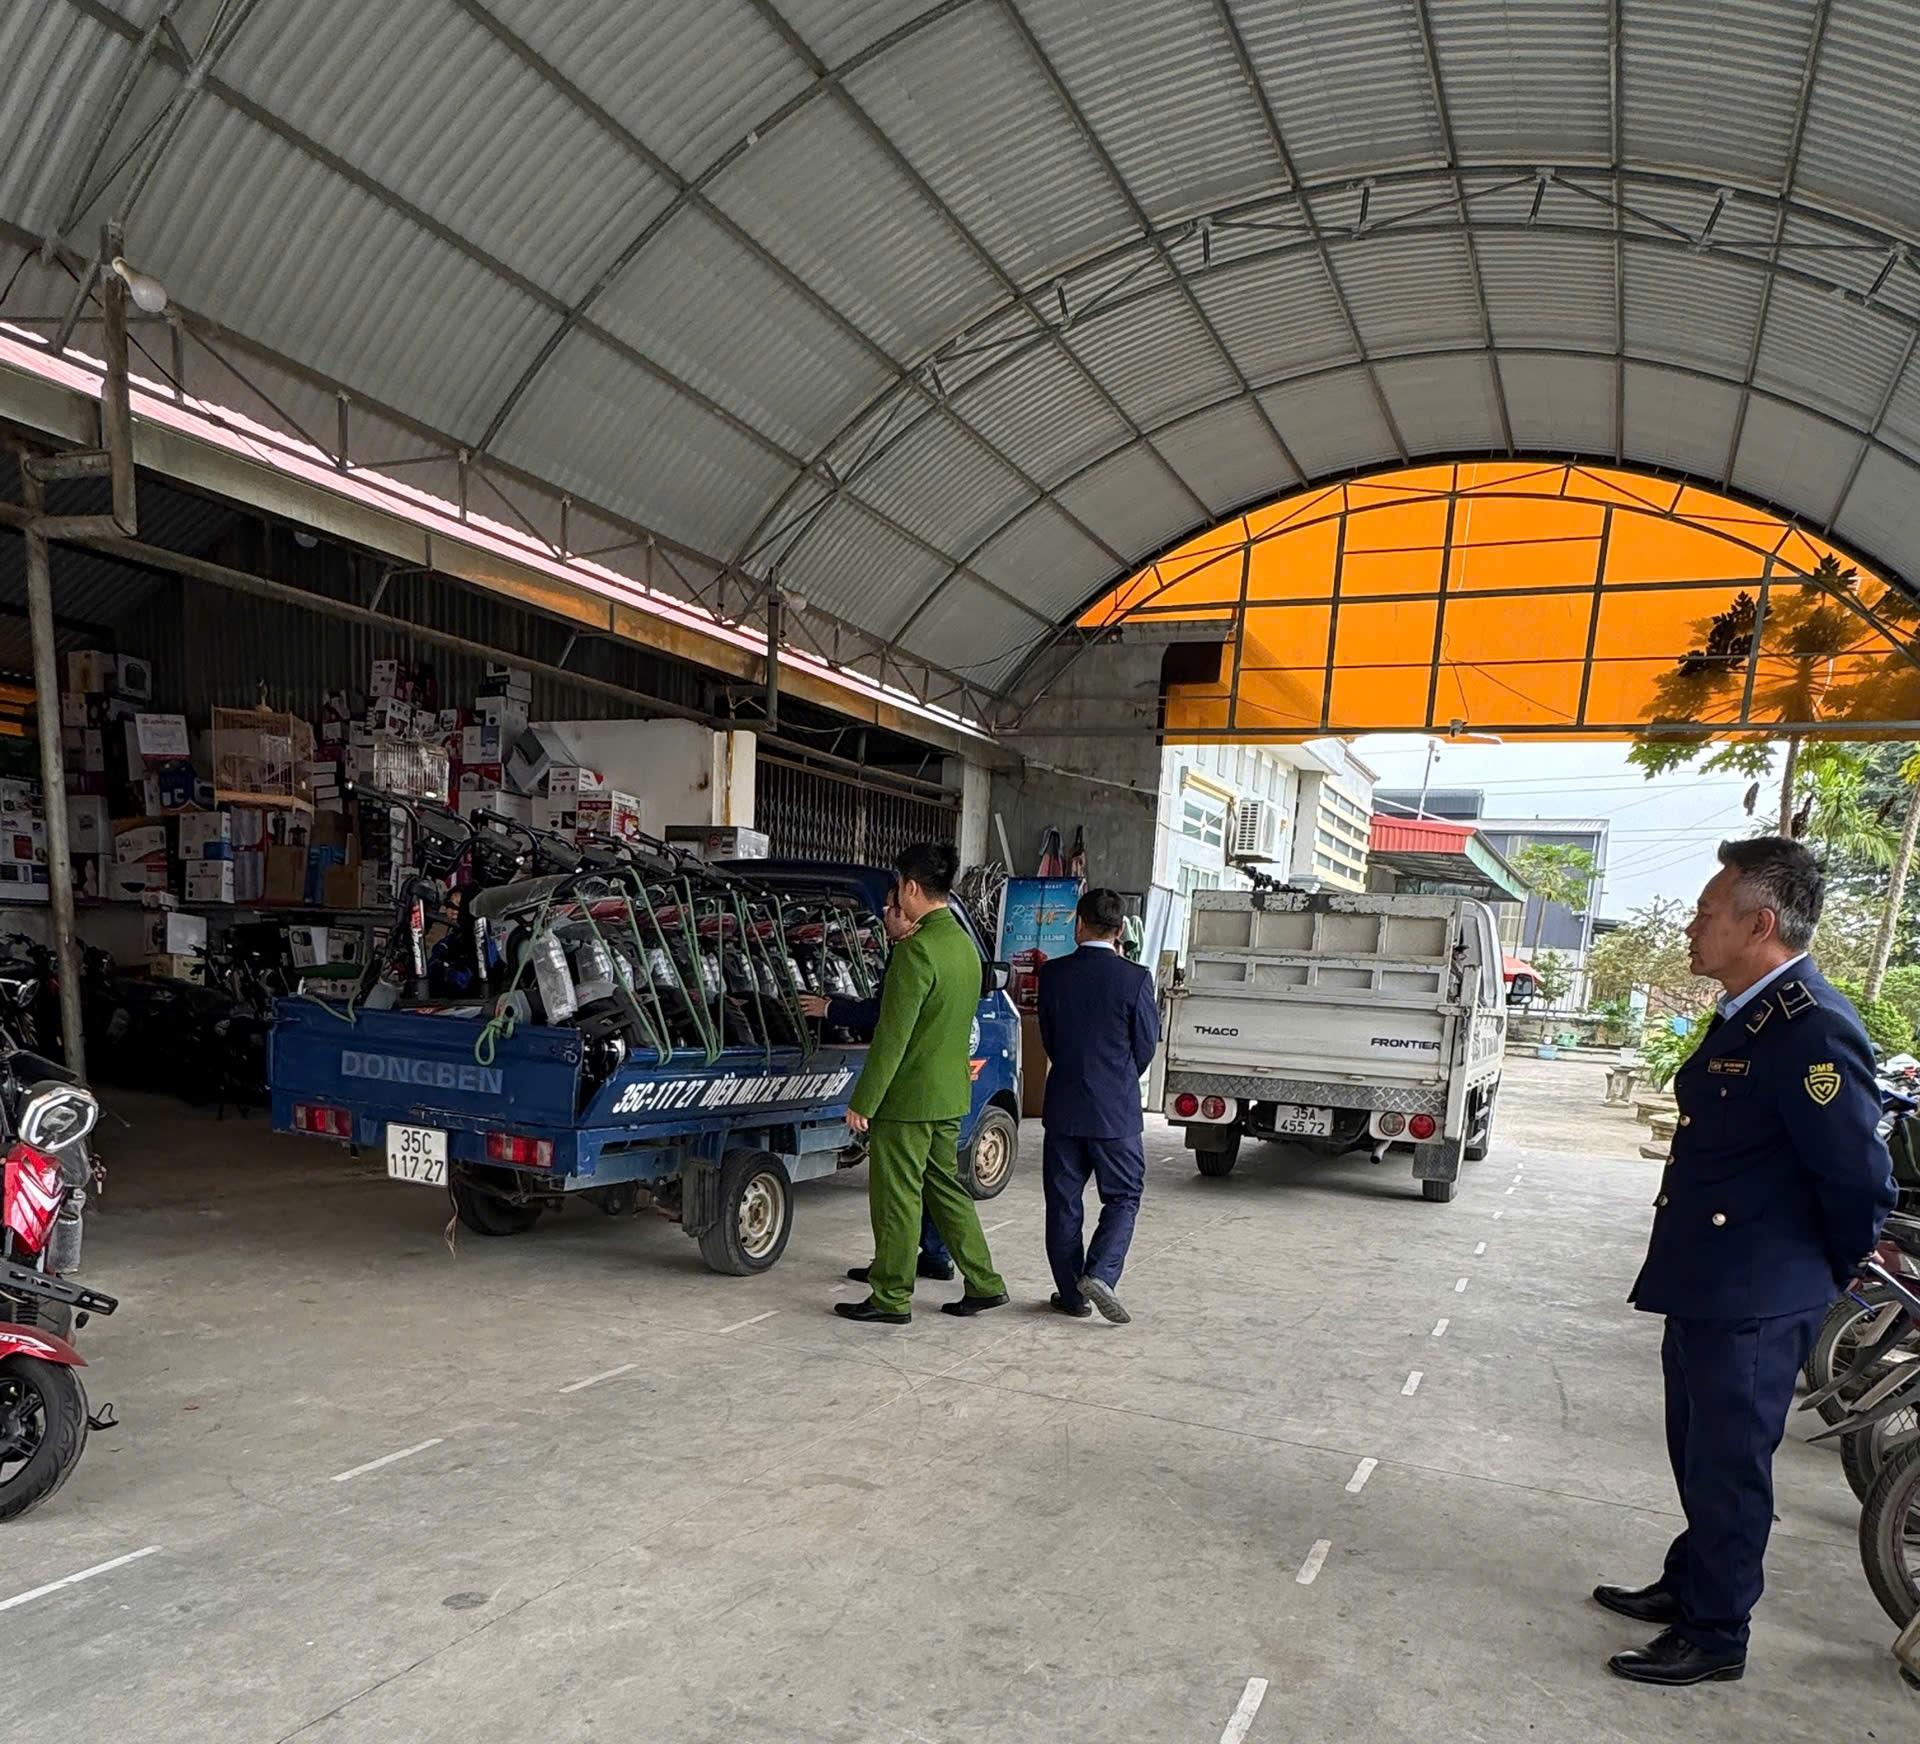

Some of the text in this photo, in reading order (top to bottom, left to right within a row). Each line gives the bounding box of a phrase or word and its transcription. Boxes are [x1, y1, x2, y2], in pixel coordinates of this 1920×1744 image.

[1194, 1026, 1239, 1037] THACO
[1371, 1037, 1441, 1051] FRONTIER
[341, 1050, 503, 1095] DONGBEN
[1809, 1062, 1834, 1074] DMS
[698, 1072, 743, 1110] ĐIỆN
[757, 1077, 787, 1103] XE
[800, 1074, 828, 1099] XE
[1292, 1106, 1316, 1120] 35A
[1281, 1119, 1325, 1134] 455.72
[401, 1129, 432, 1156] 35C
[391, 1154, 444, 1183] 117.27
